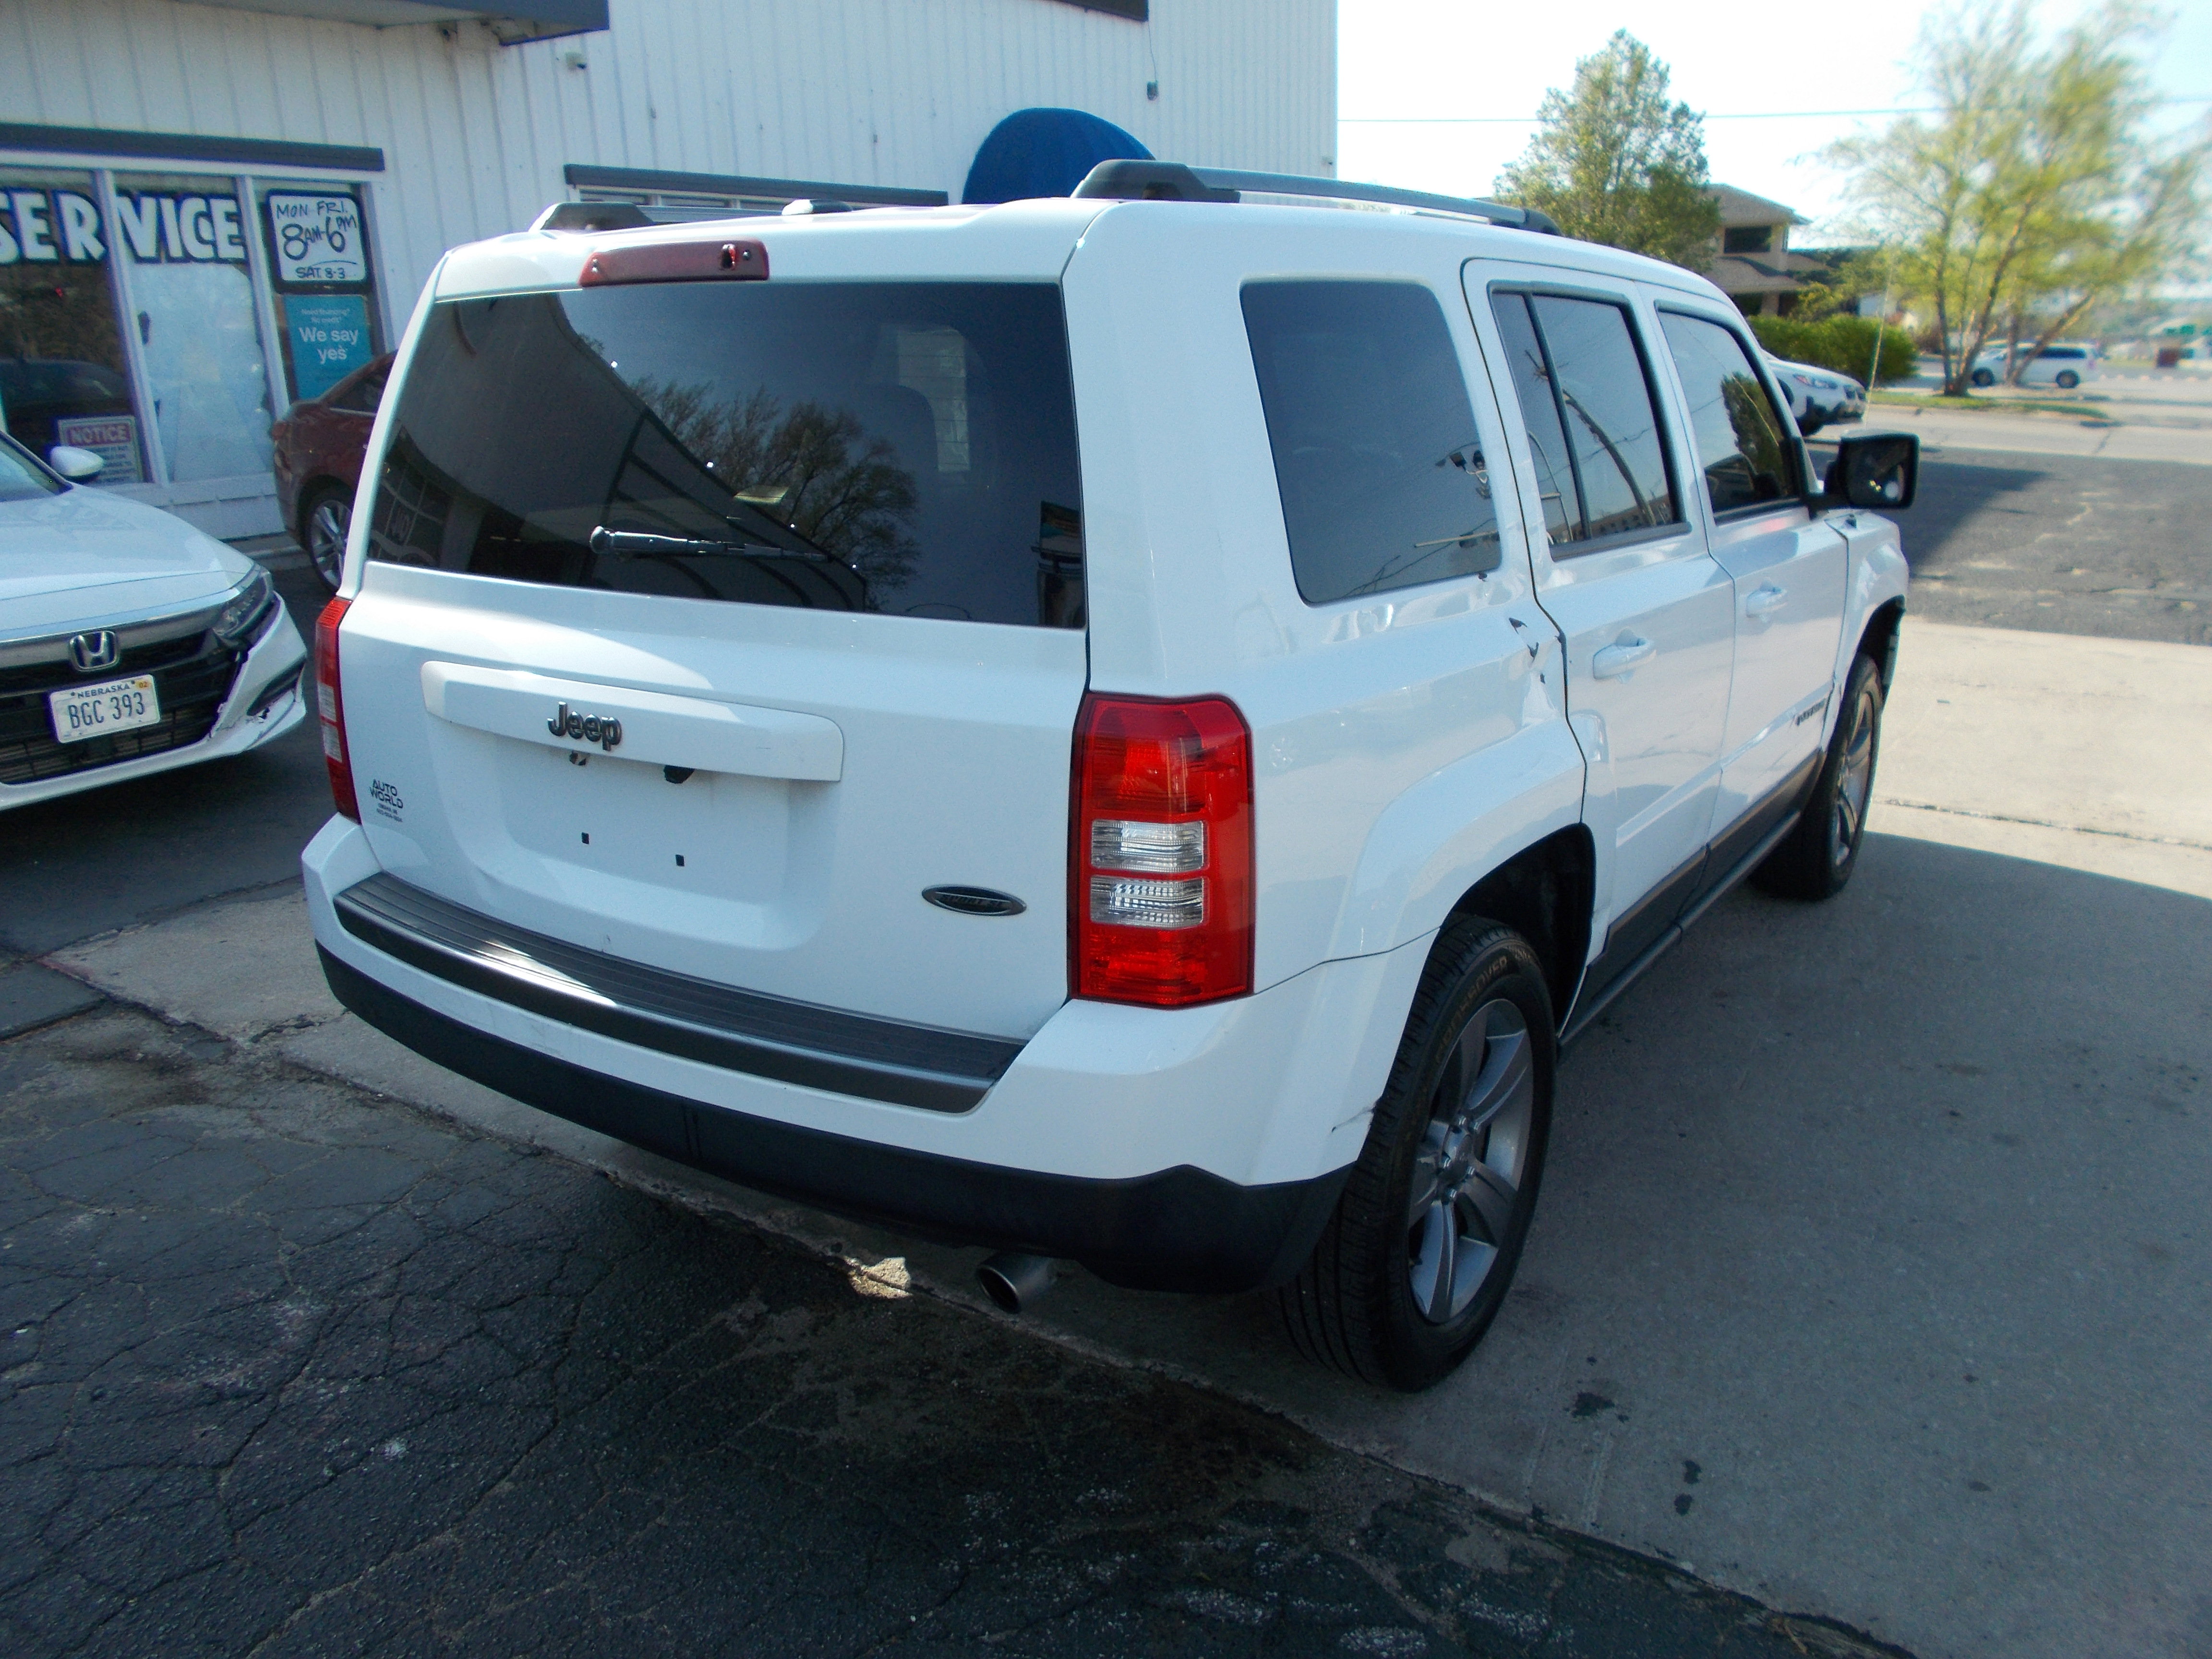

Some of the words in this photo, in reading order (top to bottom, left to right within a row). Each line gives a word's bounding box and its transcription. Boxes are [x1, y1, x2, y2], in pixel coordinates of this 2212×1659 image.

[276, 203, 308, 219] MON
[298, 327, 327, 343] We
[330, 329, 359, 346] say
[317, 348, 347, 365] yes
[72, 425, 127, 443] NOTICE
[77, 683, 131, 699] NEBRASKA
[68, 699, 105, 729] BGC
[110, 692, 145, 721] 393
[547, 701, 622, 752] Jeep
[373, 778, 397, 797] AUTO
[369, 786, 403, 809] WORLD
